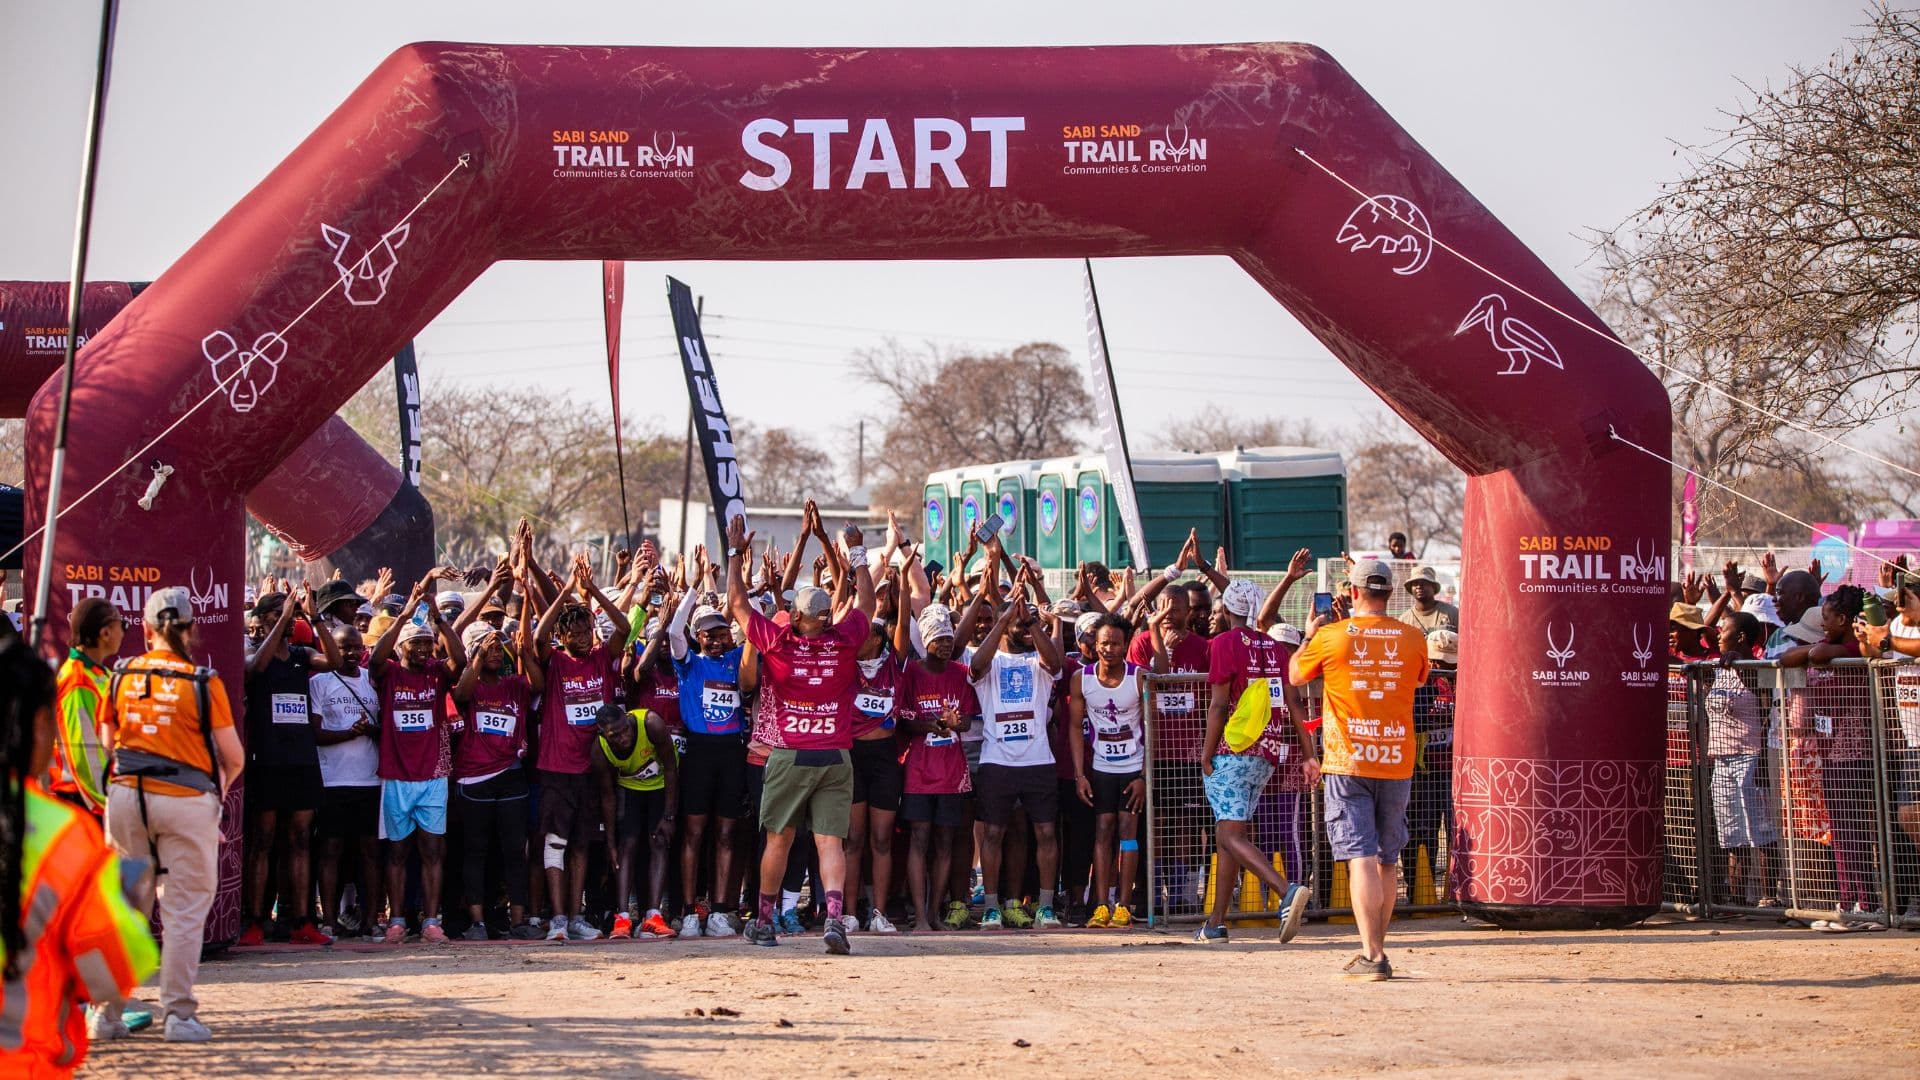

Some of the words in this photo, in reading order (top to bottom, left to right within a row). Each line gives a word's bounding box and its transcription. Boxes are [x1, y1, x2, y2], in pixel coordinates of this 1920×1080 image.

[553, 130, 585, 143] SABI
[589, 130, 630, 143] SAND
[1063, 125, 1096, 139] SABI
[1100, 125, 1142, 138] SAND
[553, 146, 630, 167] TRAIL
[739, 116, 1025, 191] START
[1064, 140, 1142, 163] TRAIL
[553, 169, 618, 179] Communities
[620, 169, 628, 179] &
[629, 169, 694, 179] Conservation
[1063, 165, 1129, 175] Communities
[1131, 164, 1139, 173] &
[1141, 163, 1207, 173] Conservation
[25, 327, 45, 335] SABI
[1519, 536, 1557, 551] SABI
[1563, 536, 1611, 551] SAND
[65, 564, 104, 581] SABI
[109, 567, 161, 582] SAND
[1519, 554, 1612, 580] TRAIL
[1519, 582, 1598, 593] Communities
[1600, 583, 1609, 593] &
[1611, 583, 1665, 595] Conservation
[1532, 671, 1557, 681] SABI
[1559, 671, 1590, 681] SAND
[1621, 672, 1640, 681] SABI
[1642, 672, 1660, 682] SAND
[330, 697, 352, 706] SABI
[711, 692, 733, 704] 244
[862, 698, 885, 711] 364
[1163, 696, 1186, 707] 334
[275, 703, 306, 714] T15323
[575, 705, 597, 718] 390
[401, 713, 425, 725] 356
[484, 715, 508, 728] 367
[784, 716, 836, 735] 2025
[1003, 723, 1028, 735] 238
[1348, 724, 1381, 737] TRAIL
[1105, 743, 1127, 754] 317
[1350, 742, 1403, 764] 2025
